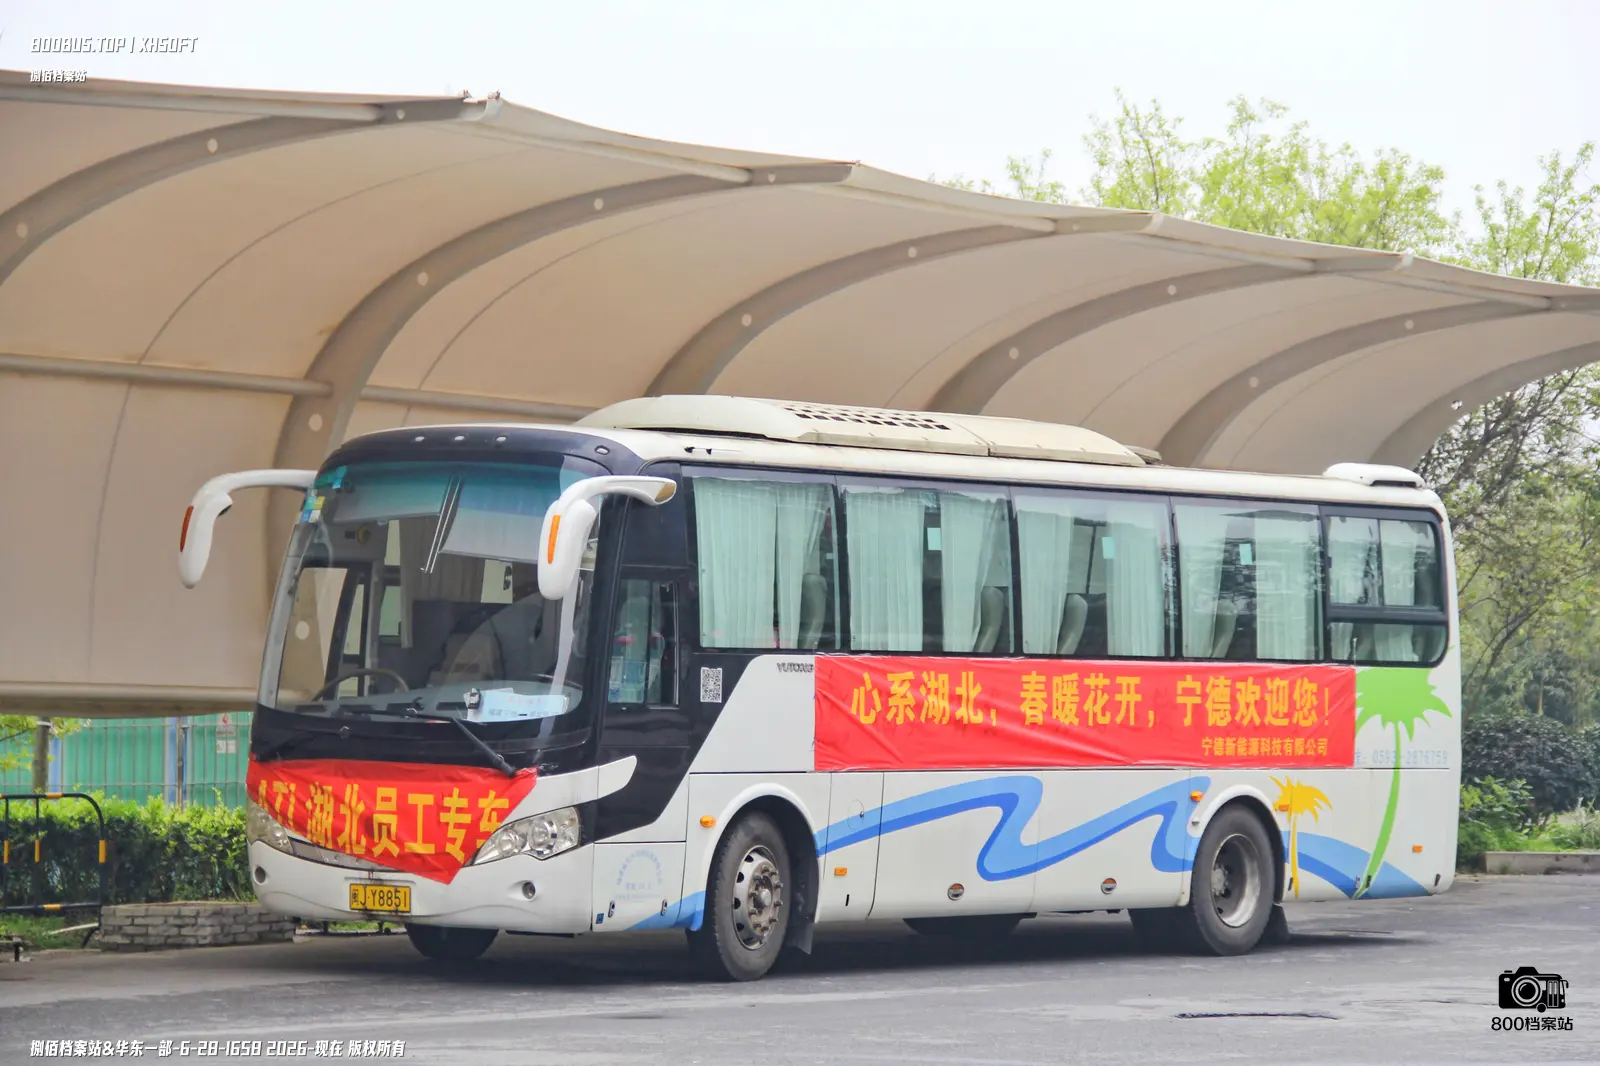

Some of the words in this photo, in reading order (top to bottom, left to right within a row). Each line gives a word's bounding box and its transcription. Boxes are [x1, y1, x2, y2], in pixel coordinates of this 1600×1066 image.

[776, 662, 814, 673] YUTONG
[1202, 737, 1328, 756] 宁德新能源科技有限公司
